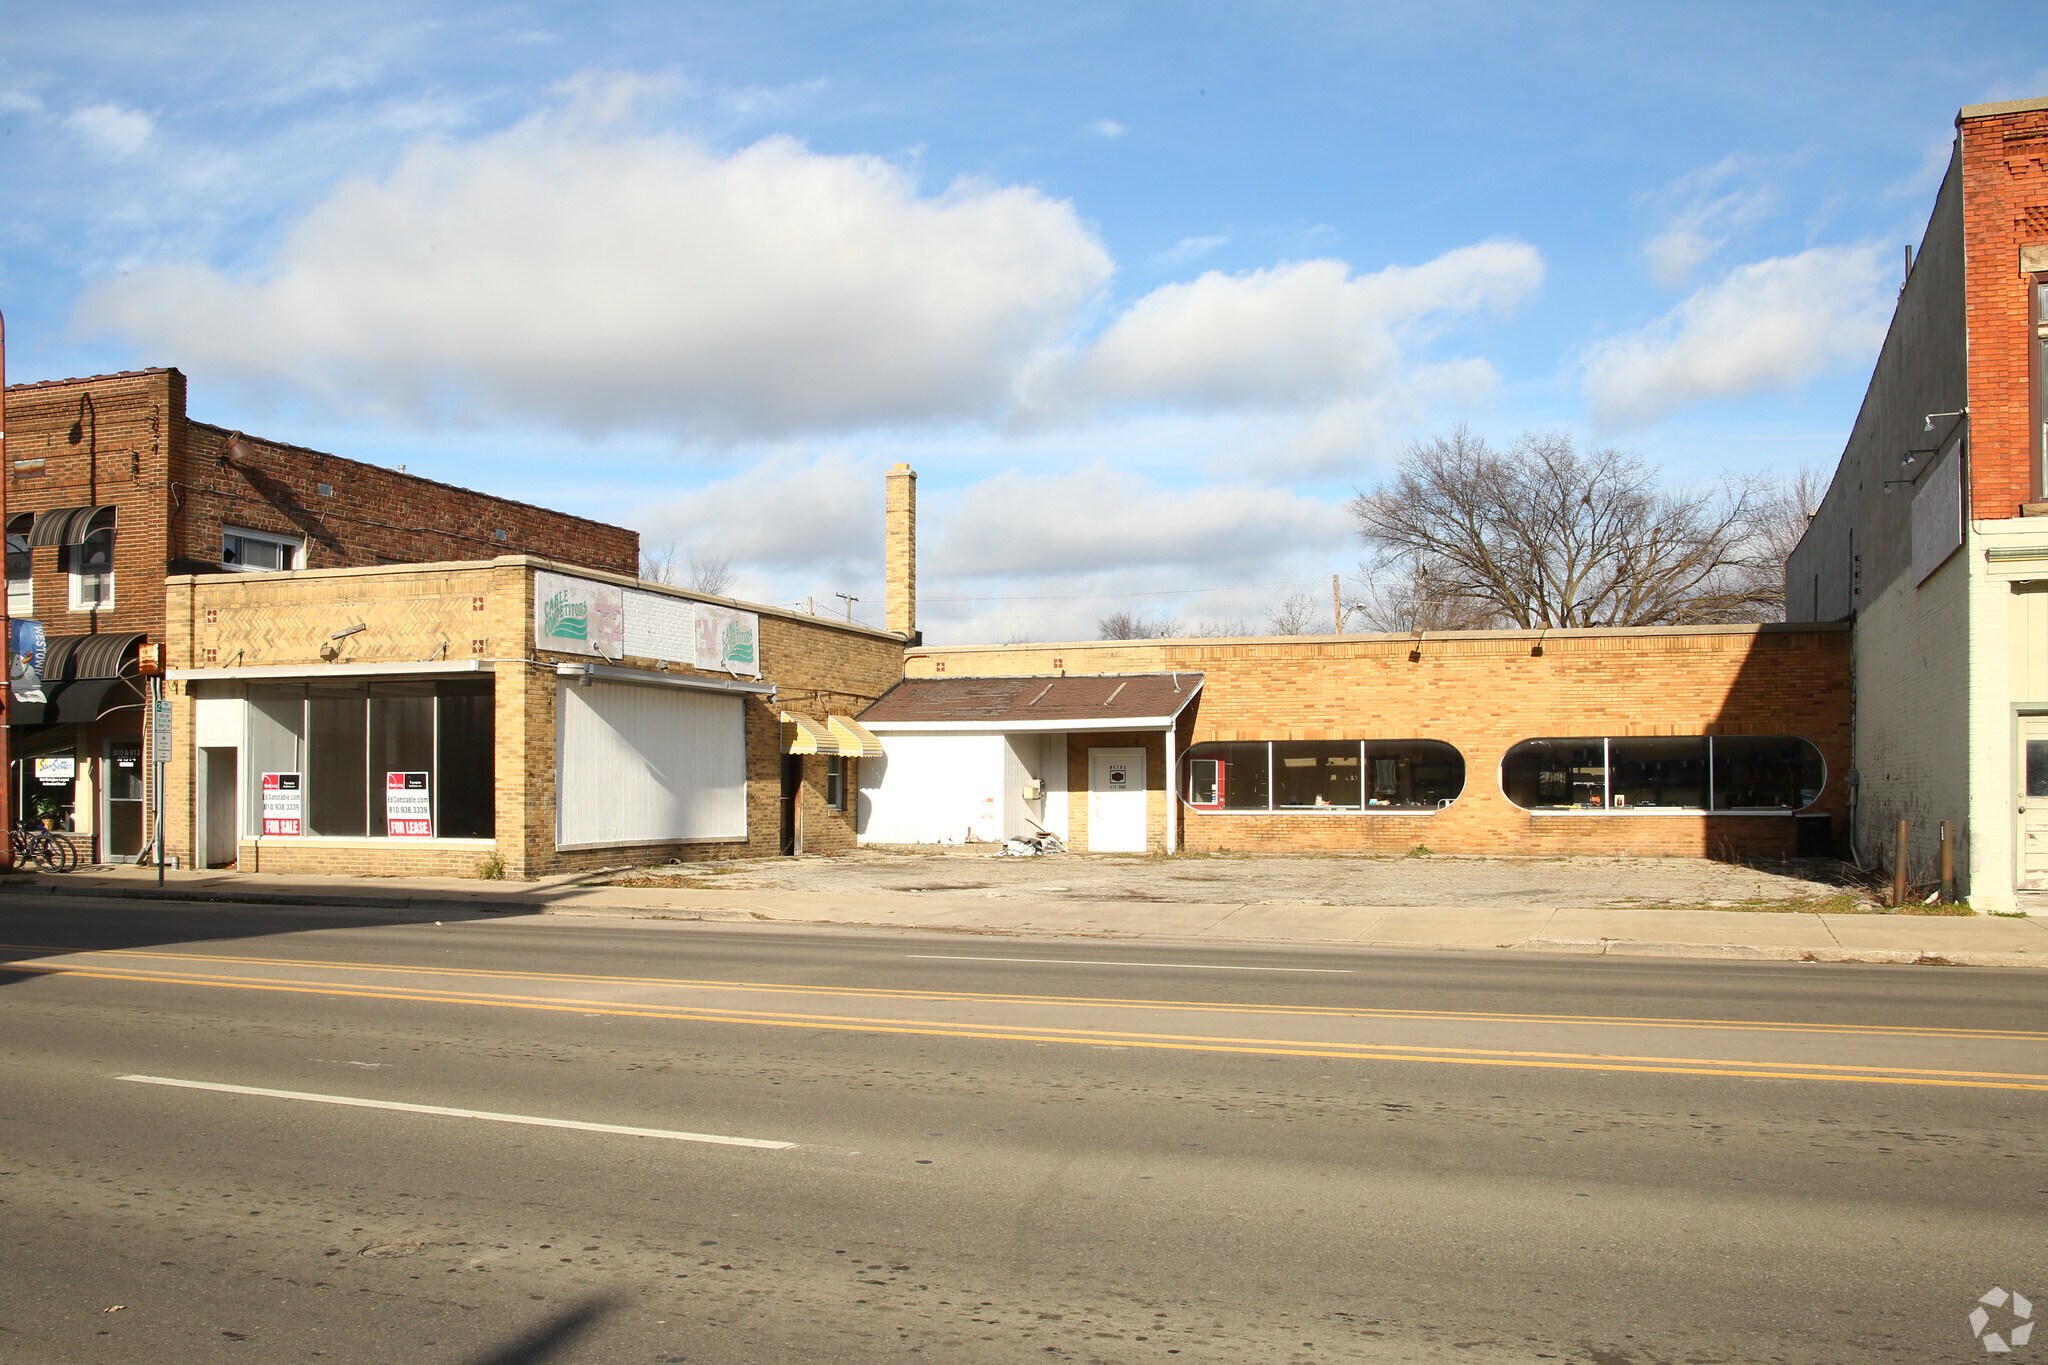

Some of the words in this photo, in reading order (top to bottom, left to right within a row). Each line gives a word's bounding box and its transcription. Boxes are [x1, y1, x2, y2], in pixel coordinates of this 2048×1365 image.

[544, 590, 568, 618] CABLE
[544, 601, 588, 638] COMPETITORS
[34, 623, 47, 676] WESTOWN
[263, 803, 300, 811] 810.938.3339
[388, 806, 428, 814] 810.938.3339
[265, 820, 280, 834] FOR
[280, 820, 298, 834] SALE
[390, 821, 405, 835] FOR
[405, 821, 428, 835] LEASE
